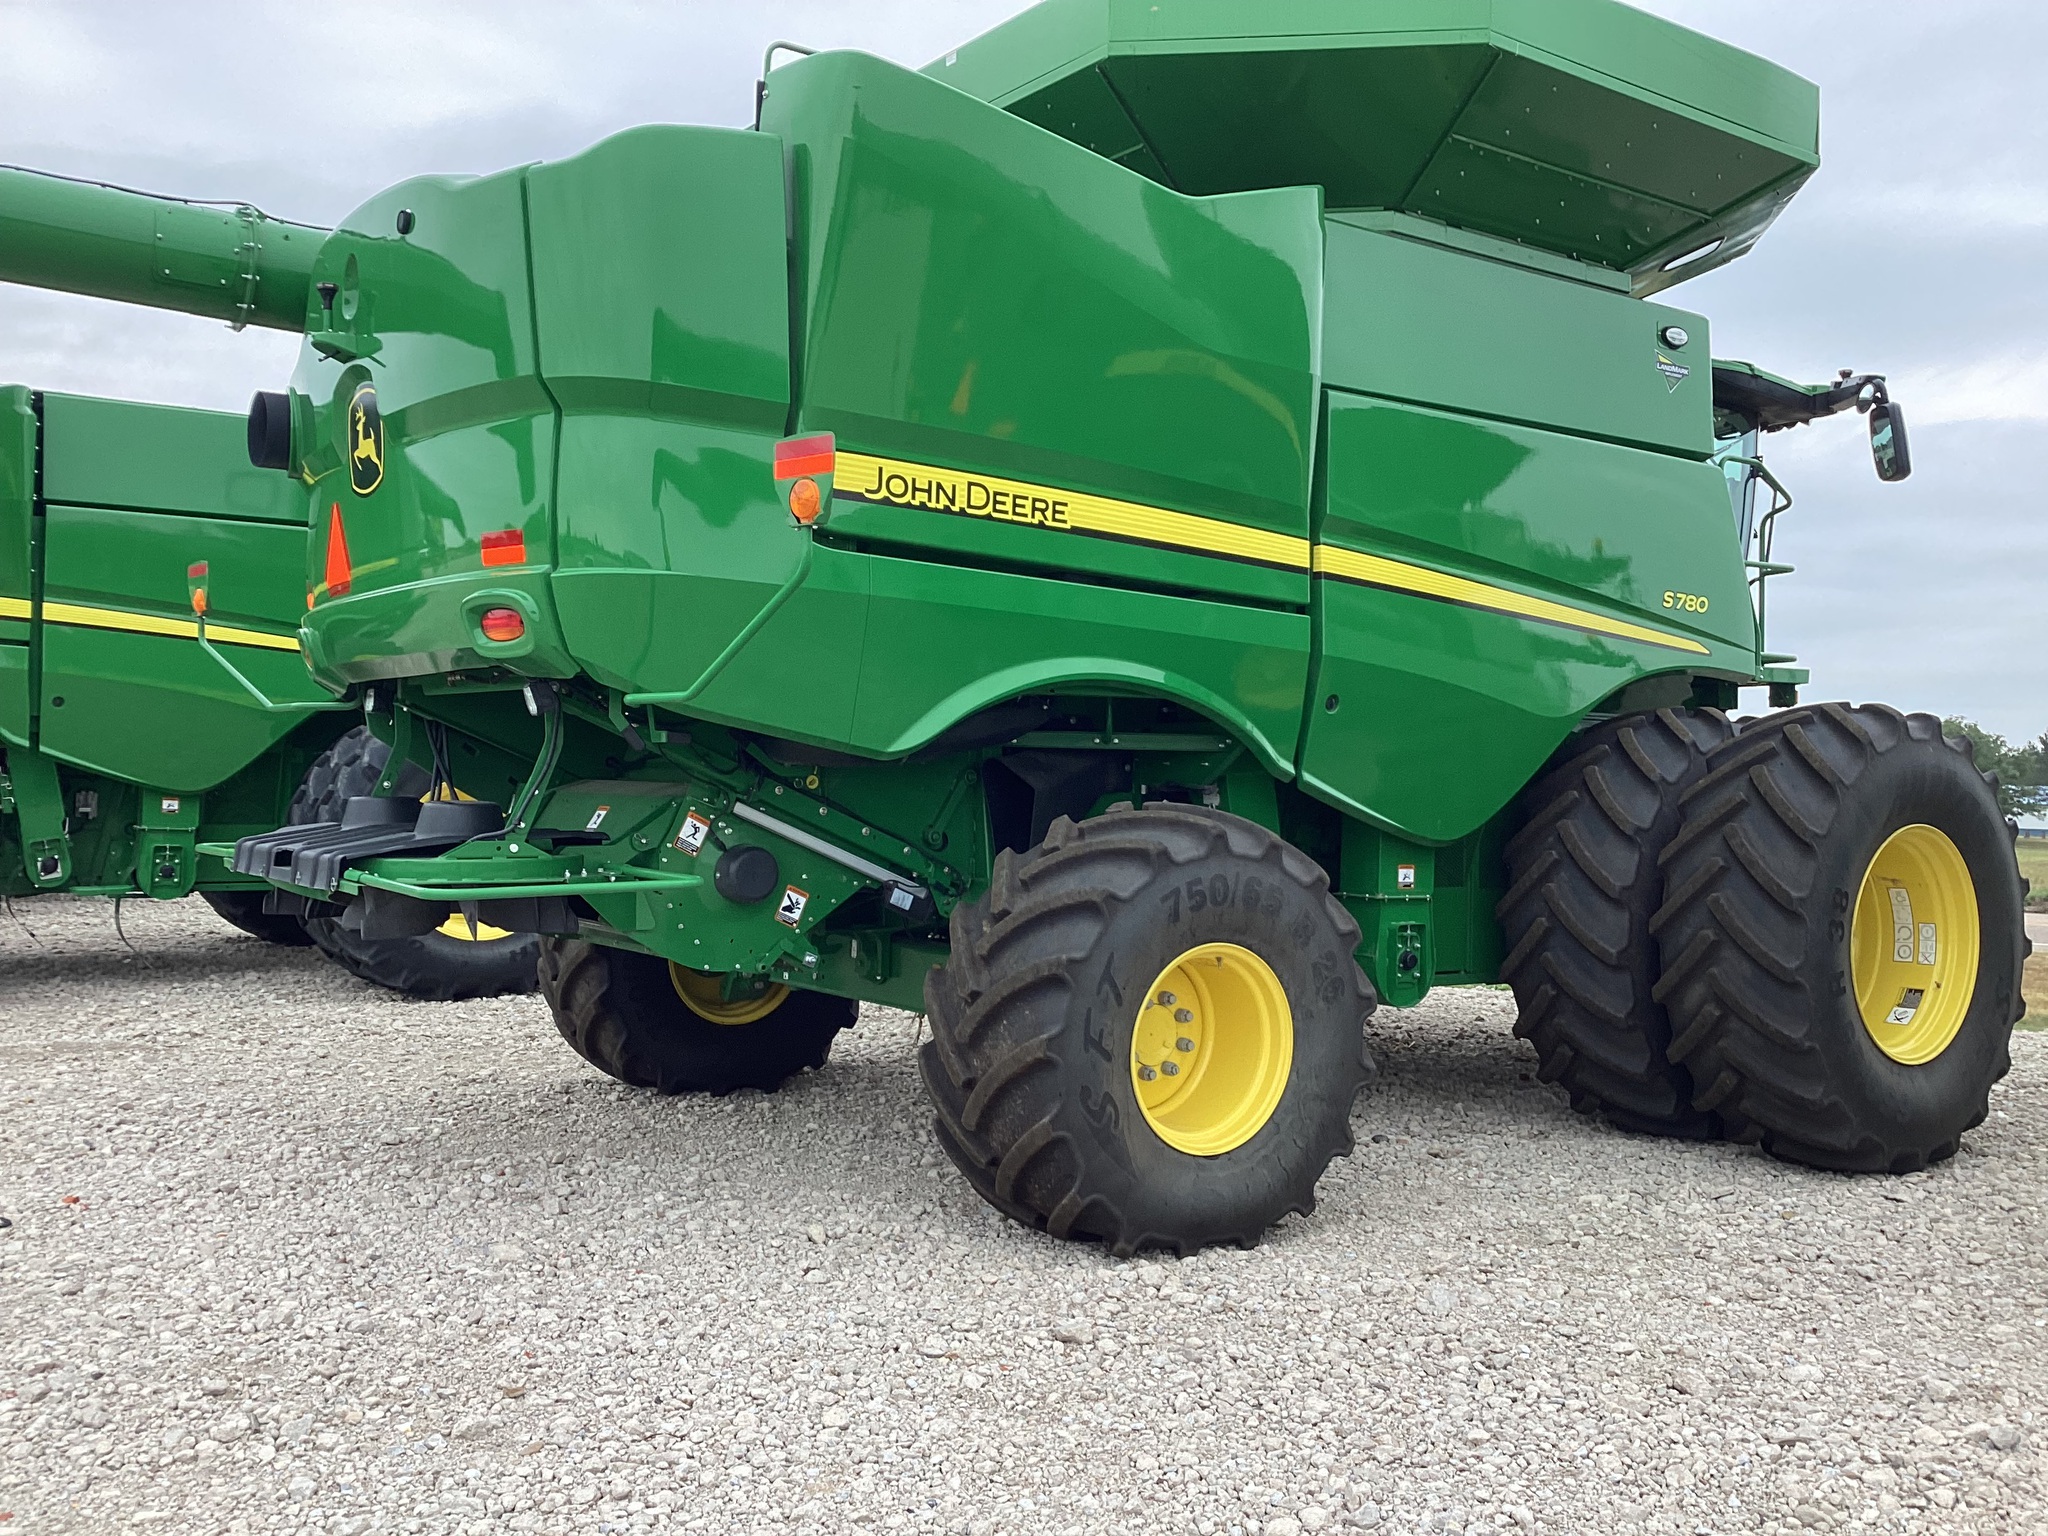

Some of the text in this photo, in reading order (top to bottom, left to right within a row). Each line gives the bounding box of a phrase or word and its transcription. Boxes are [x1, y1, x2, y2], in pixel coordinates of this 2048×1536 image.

[864, 465, 1069, 525] JOHN DEERE
[1662, 590, 1709, 613] S780
